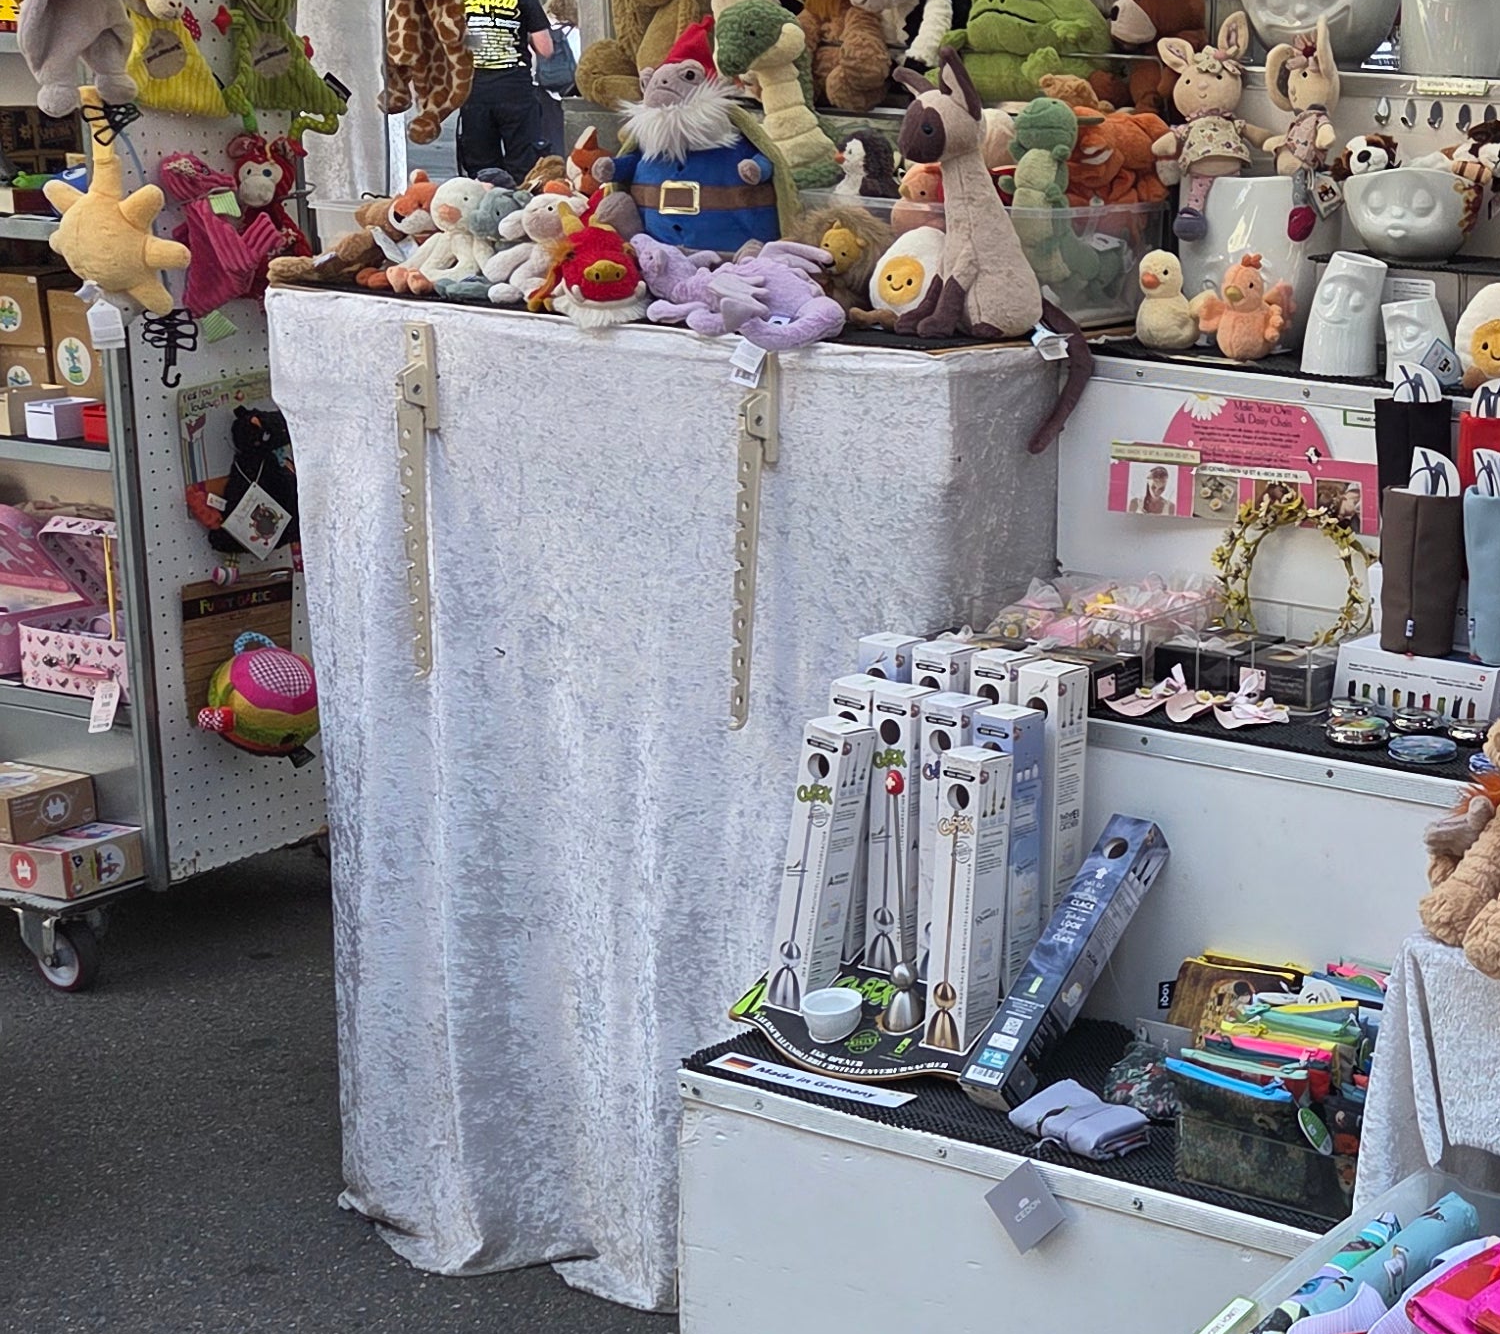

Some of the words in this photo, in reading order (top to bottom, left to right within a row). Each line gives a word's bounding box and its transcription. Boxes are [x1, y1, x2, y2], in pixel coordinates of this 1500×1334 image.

[1257, 404, 1272, 414] Your
[1274, 405, 1293, 416] Own
[1248, 414, 1269, 428] Daisy
[1270, 415, 1293, 428] Chain
[756, 1066, 794, 1081] Made
[796, 1073, 812, 1084] in
[814, 1080, 877, 1098] Germany
